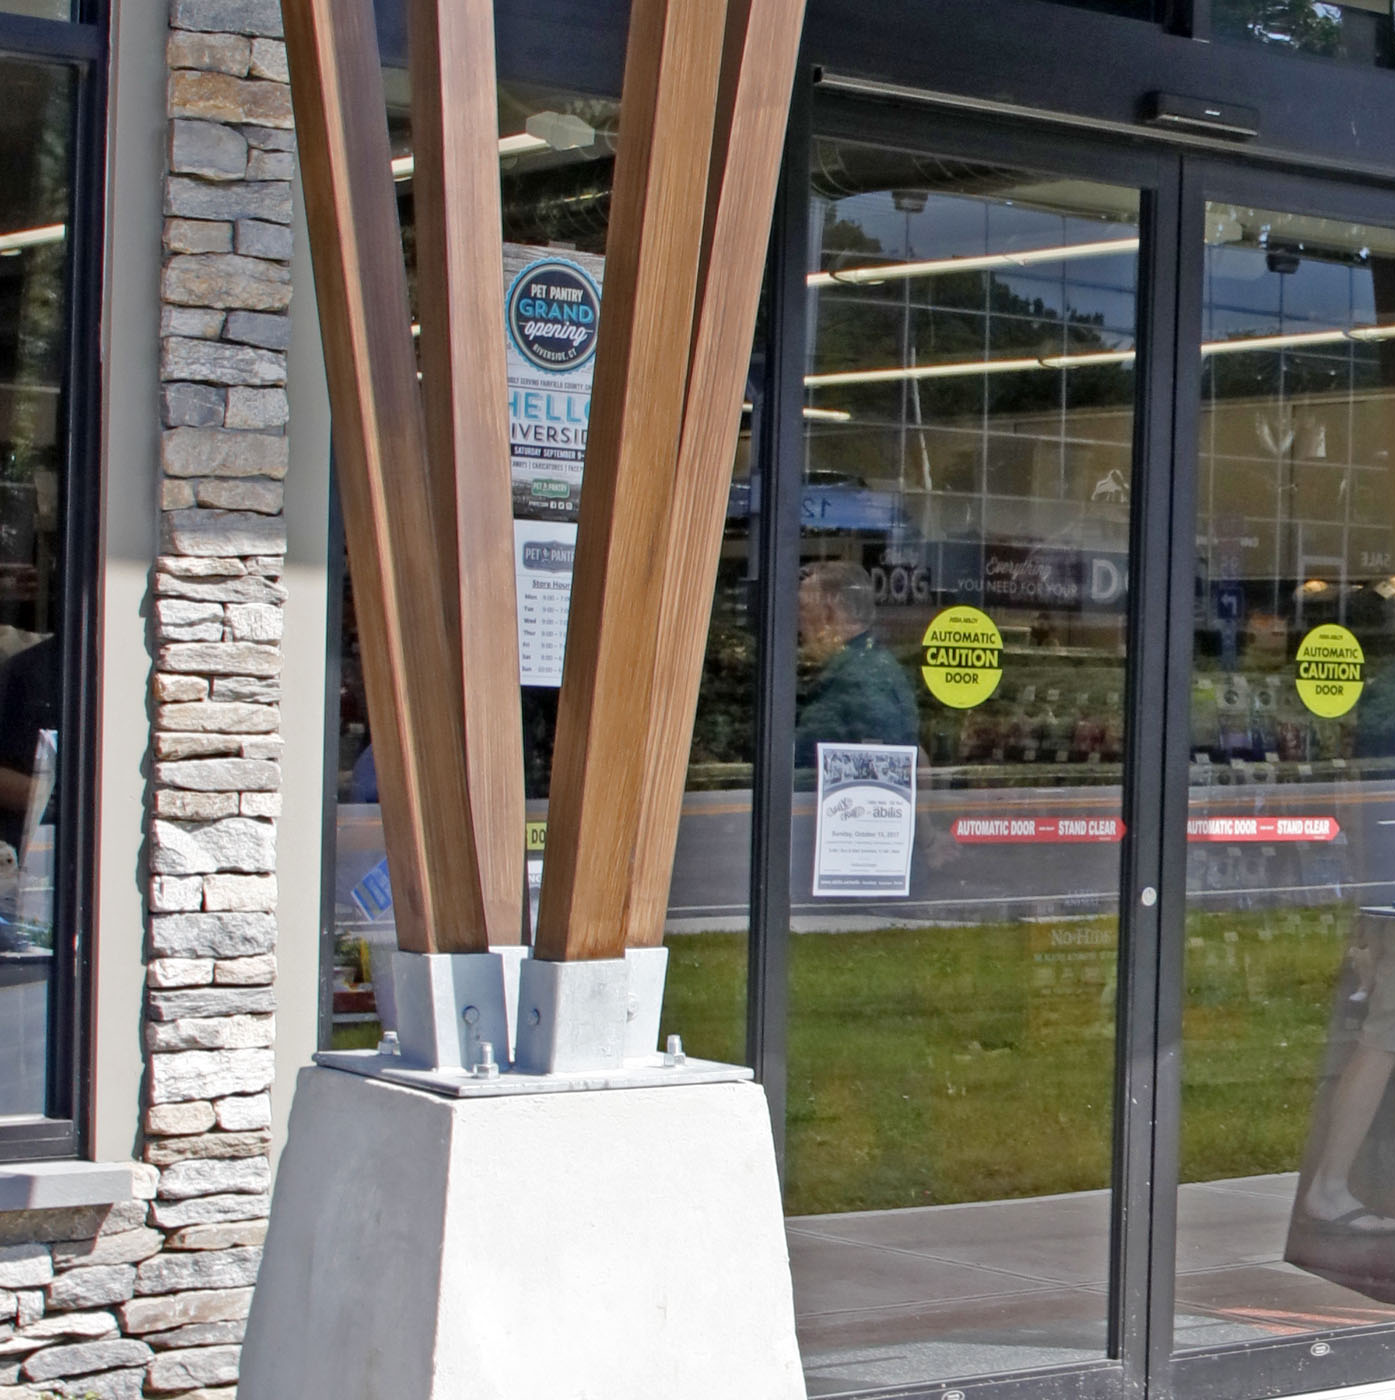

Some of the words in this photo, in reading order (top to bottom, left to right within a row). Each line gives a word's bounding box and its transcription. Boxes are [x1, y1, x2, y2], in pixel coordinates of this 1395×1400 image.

[531, 284, 546, 298] PET
[550, 285, 584, 302] PANTRY
[519, 298, 594, 324] GRAND
[524, 320, 588, 346] opening
[543, 448, 576, 459] SEPTEMBER
[525, 547, 540, 561] PET
[552, 580, 570, 590] Hour
[871, 566, 929, 603] DOG
[957, 578, 982, 591] YOU
[987, 580, 1016, 594] NEED
[930, 630, 996, 645] AUTOMATIC
[926, 647, 999, 668] CAUTION
[1302, 646, 1359, 659] AUTOMATIC
[945, 671, 980, 684] DOOR
[1299, 662, 1360, 680] CAUTION
[1315, 684, 1344, 696] DOOR
[957, 819, 1009, 836] AUTOMATIC
[1010, 819, 1036, 836] DOOR
[1058, 819, 1087, 836] STAND
[1088, 819, 1117, 836] CLEAR
[1187, 819, 1233, 835] AUTOMATIC
[1234, 819, 1257, 835] DOOR
[1277, 819, 1303, 835] STAND
[1304, 819, 1330, 835] CLEAR
